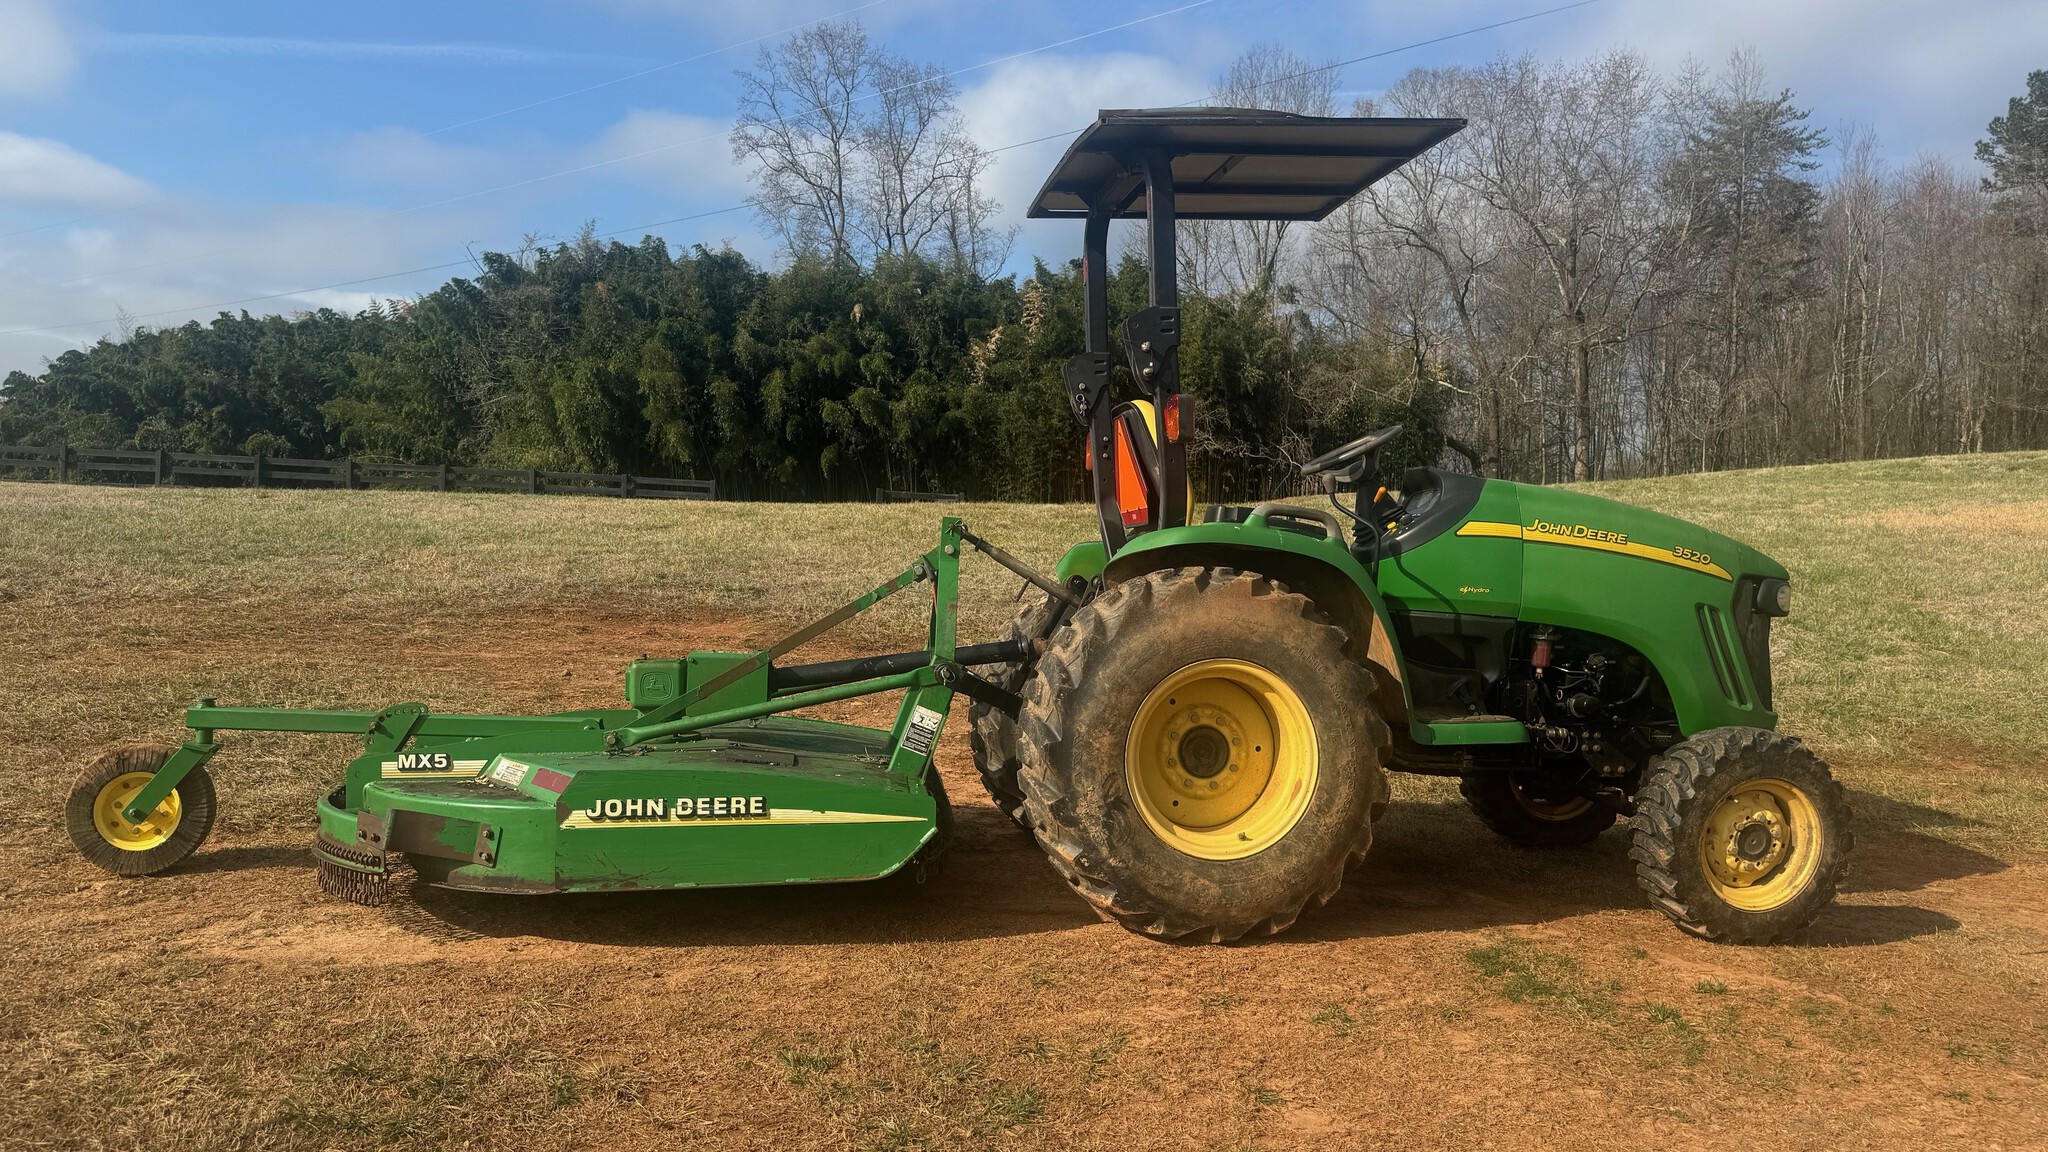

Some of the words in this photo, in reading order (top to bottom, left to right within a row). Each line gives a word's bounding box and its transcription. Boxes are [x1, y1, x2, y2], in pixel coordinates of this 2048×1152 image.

[1526, 518, 1573, 537] JOHN
[1573, 524, 1628, 545] DEERE
[1672, 546, 1712, 565] 3520
[398, 753, 449, 769] MX5
[586, 798, 666, 818] JOHN
[676, 796, 765, 817] DEERE
